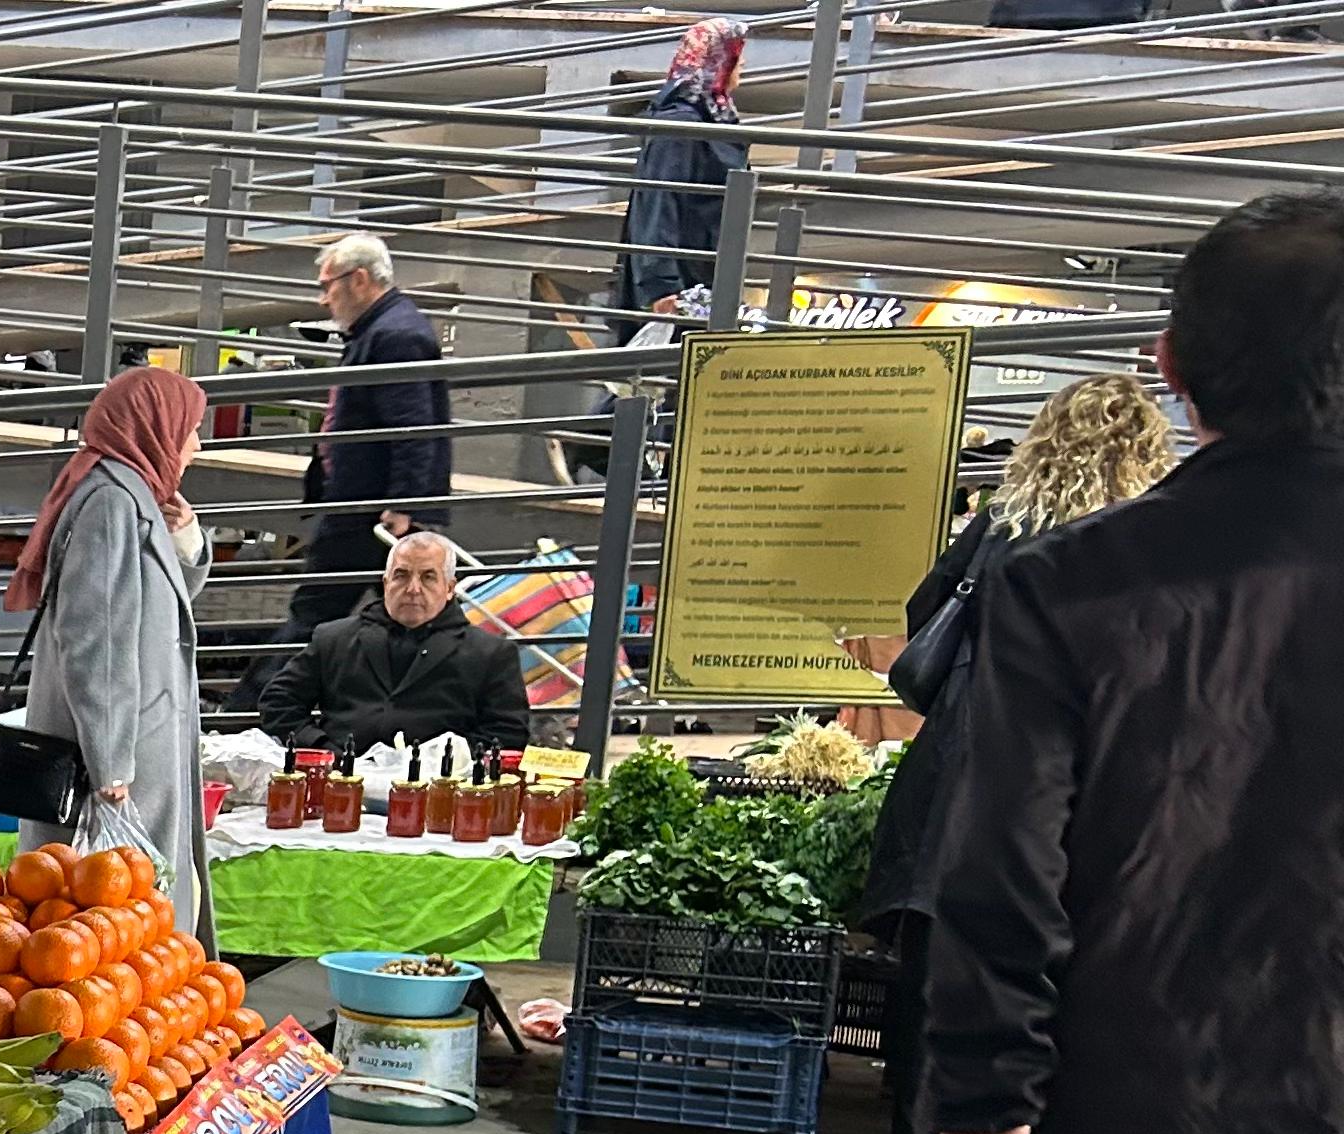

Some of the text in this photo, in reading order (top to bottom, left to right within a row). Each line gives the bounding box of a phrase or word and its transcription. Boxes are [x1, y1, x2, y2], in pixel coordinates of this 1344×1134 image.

[790, 367, 836, 379] KURBAN
[839, 366, 872, 378] NASIL
[874, 363, 926, 378] KESİLİR?
[692, 653, 799, 669] MERKEZEFENDİ
